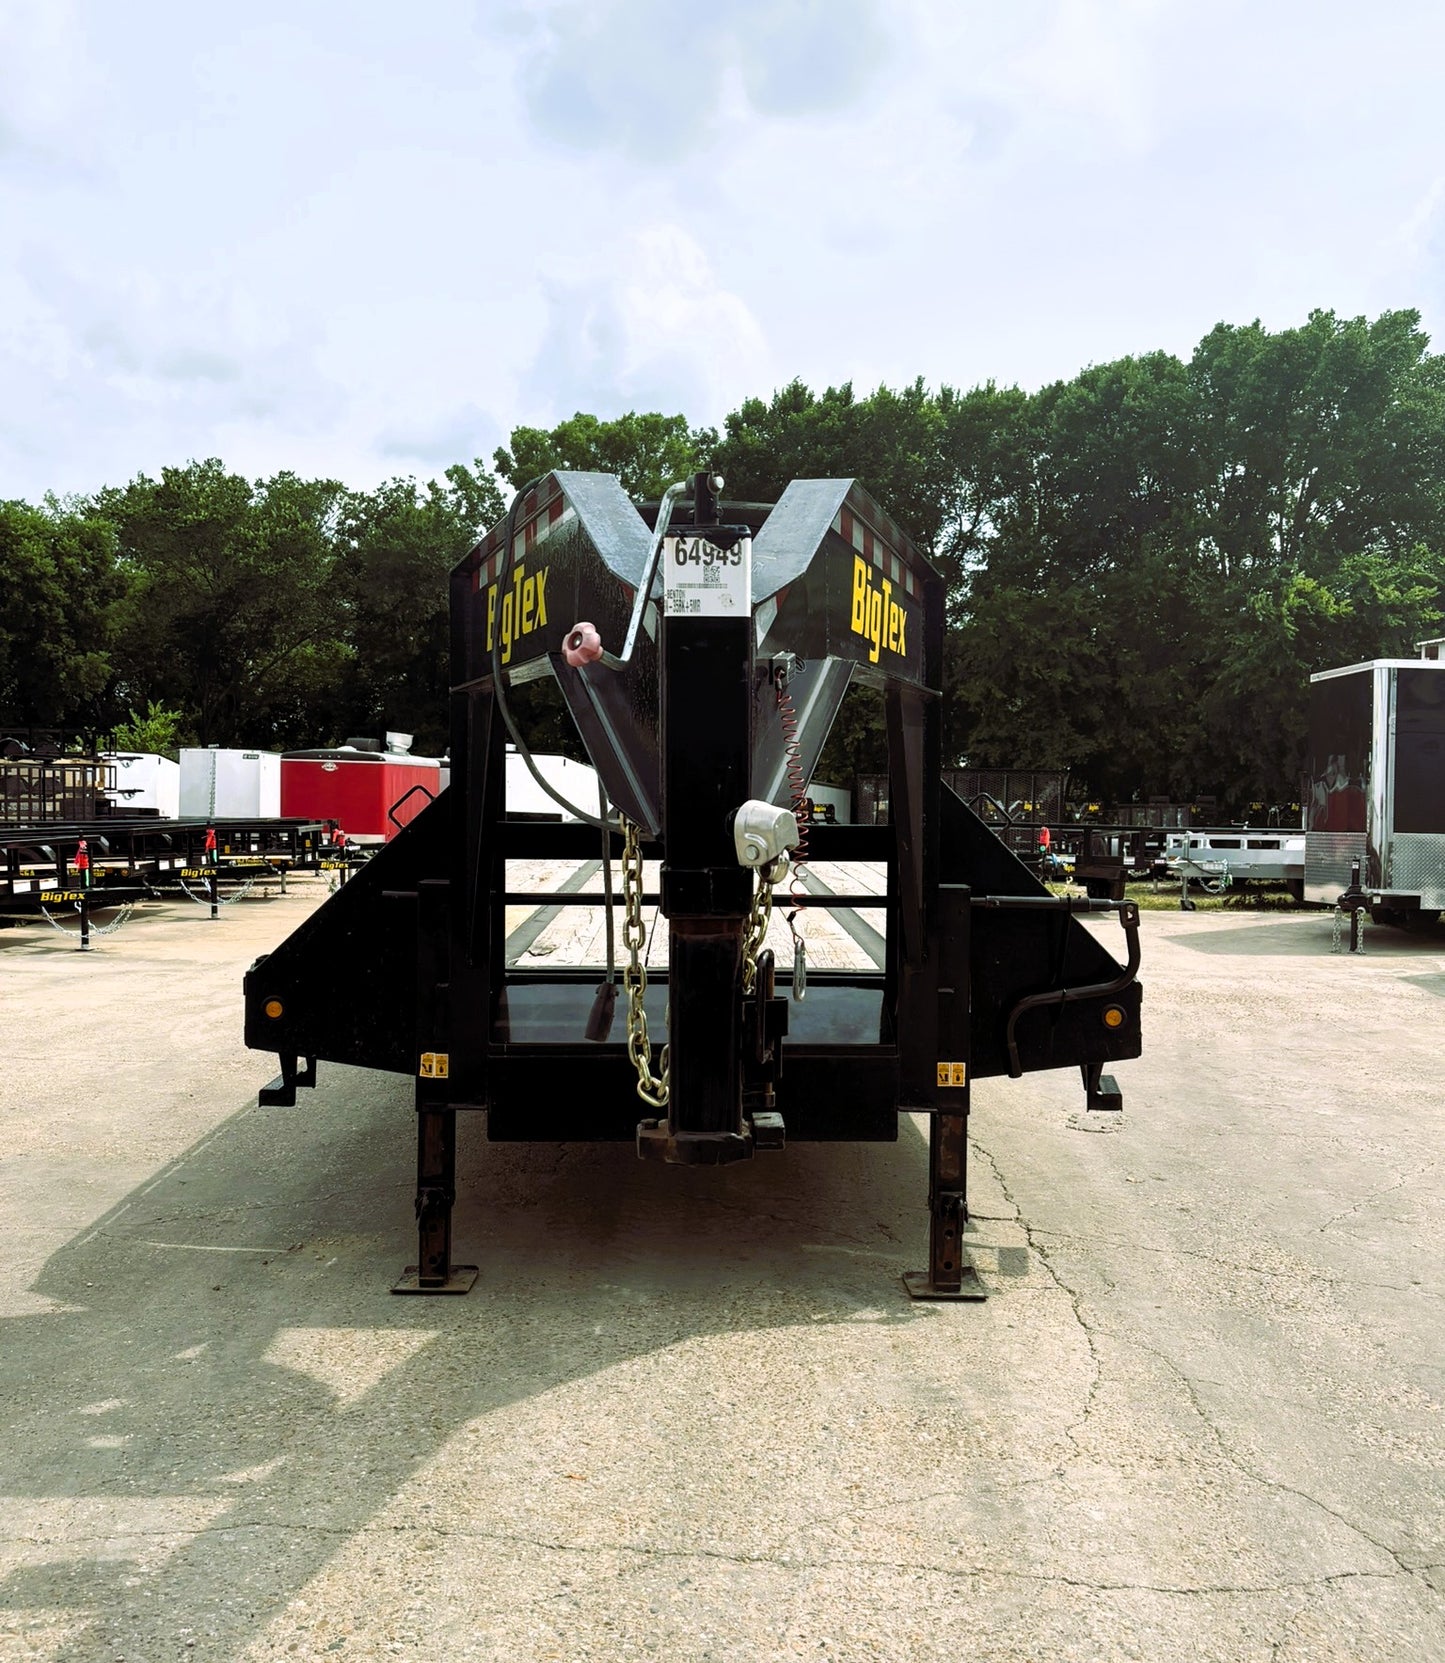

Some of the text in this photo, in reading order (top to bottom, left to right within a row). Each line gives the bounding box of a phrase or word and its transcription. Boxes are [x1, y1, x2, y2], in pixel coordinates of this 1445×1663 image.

[675, 539, 743, 566] 64949
[486, 563, 549, 664] BgTex
[850, 554, 908, 664] BigTex
[180, 868, 217, 878] BigTex
[320, 861, 349, 871] BigTex
[40, 891, 86, 903] BigTex
